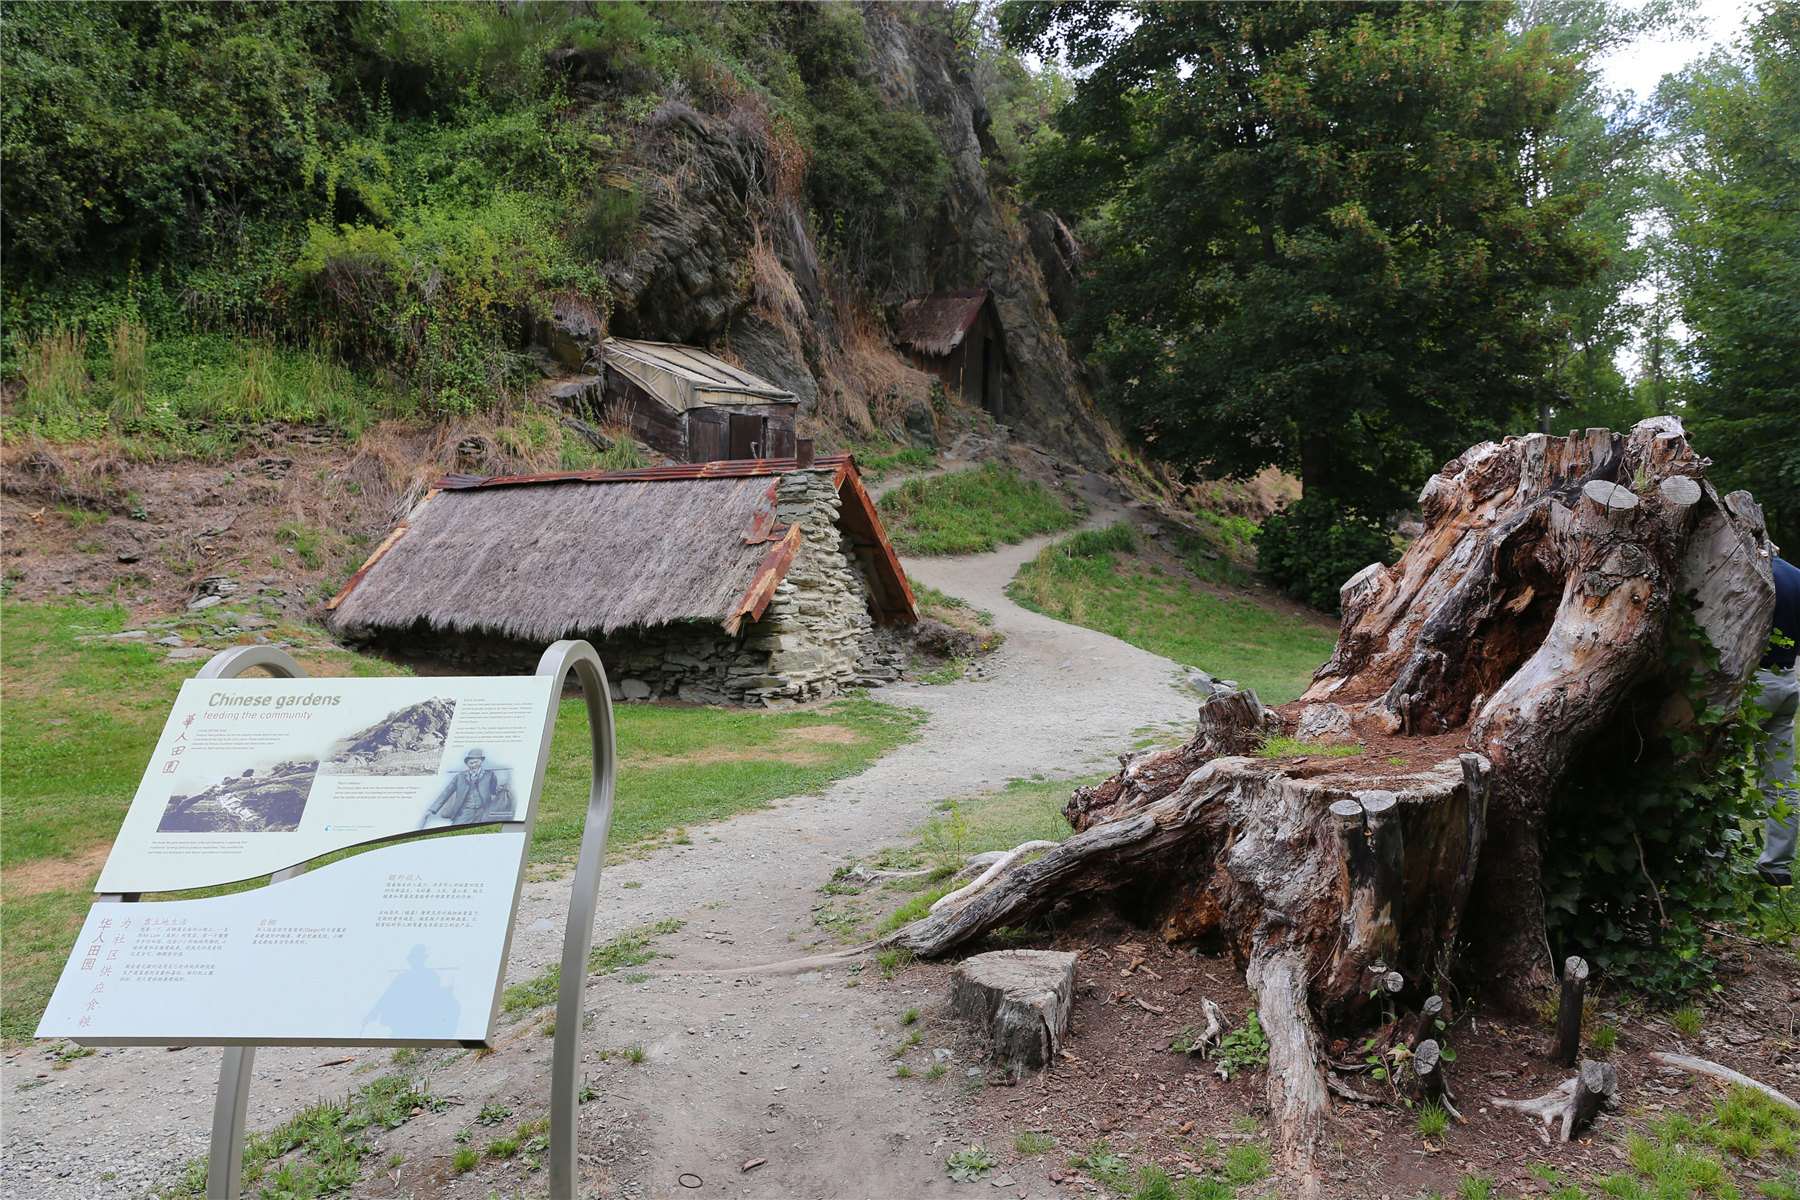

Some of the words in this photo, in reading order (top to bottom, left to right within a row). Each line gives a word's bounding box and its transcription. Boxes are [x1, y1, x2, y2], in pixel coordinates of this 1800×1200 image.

[203, 711, 239, 721] feeding
[242, 711, 258, 720] the
[260, 711, 313, 721] community
[209, 692, 272, 707] Chinese
[275, 692, 342, 709] gardens
[81, 918, 112, 970] 华人田园
[78, 917, 131, 1028] 为社区供应食粮
